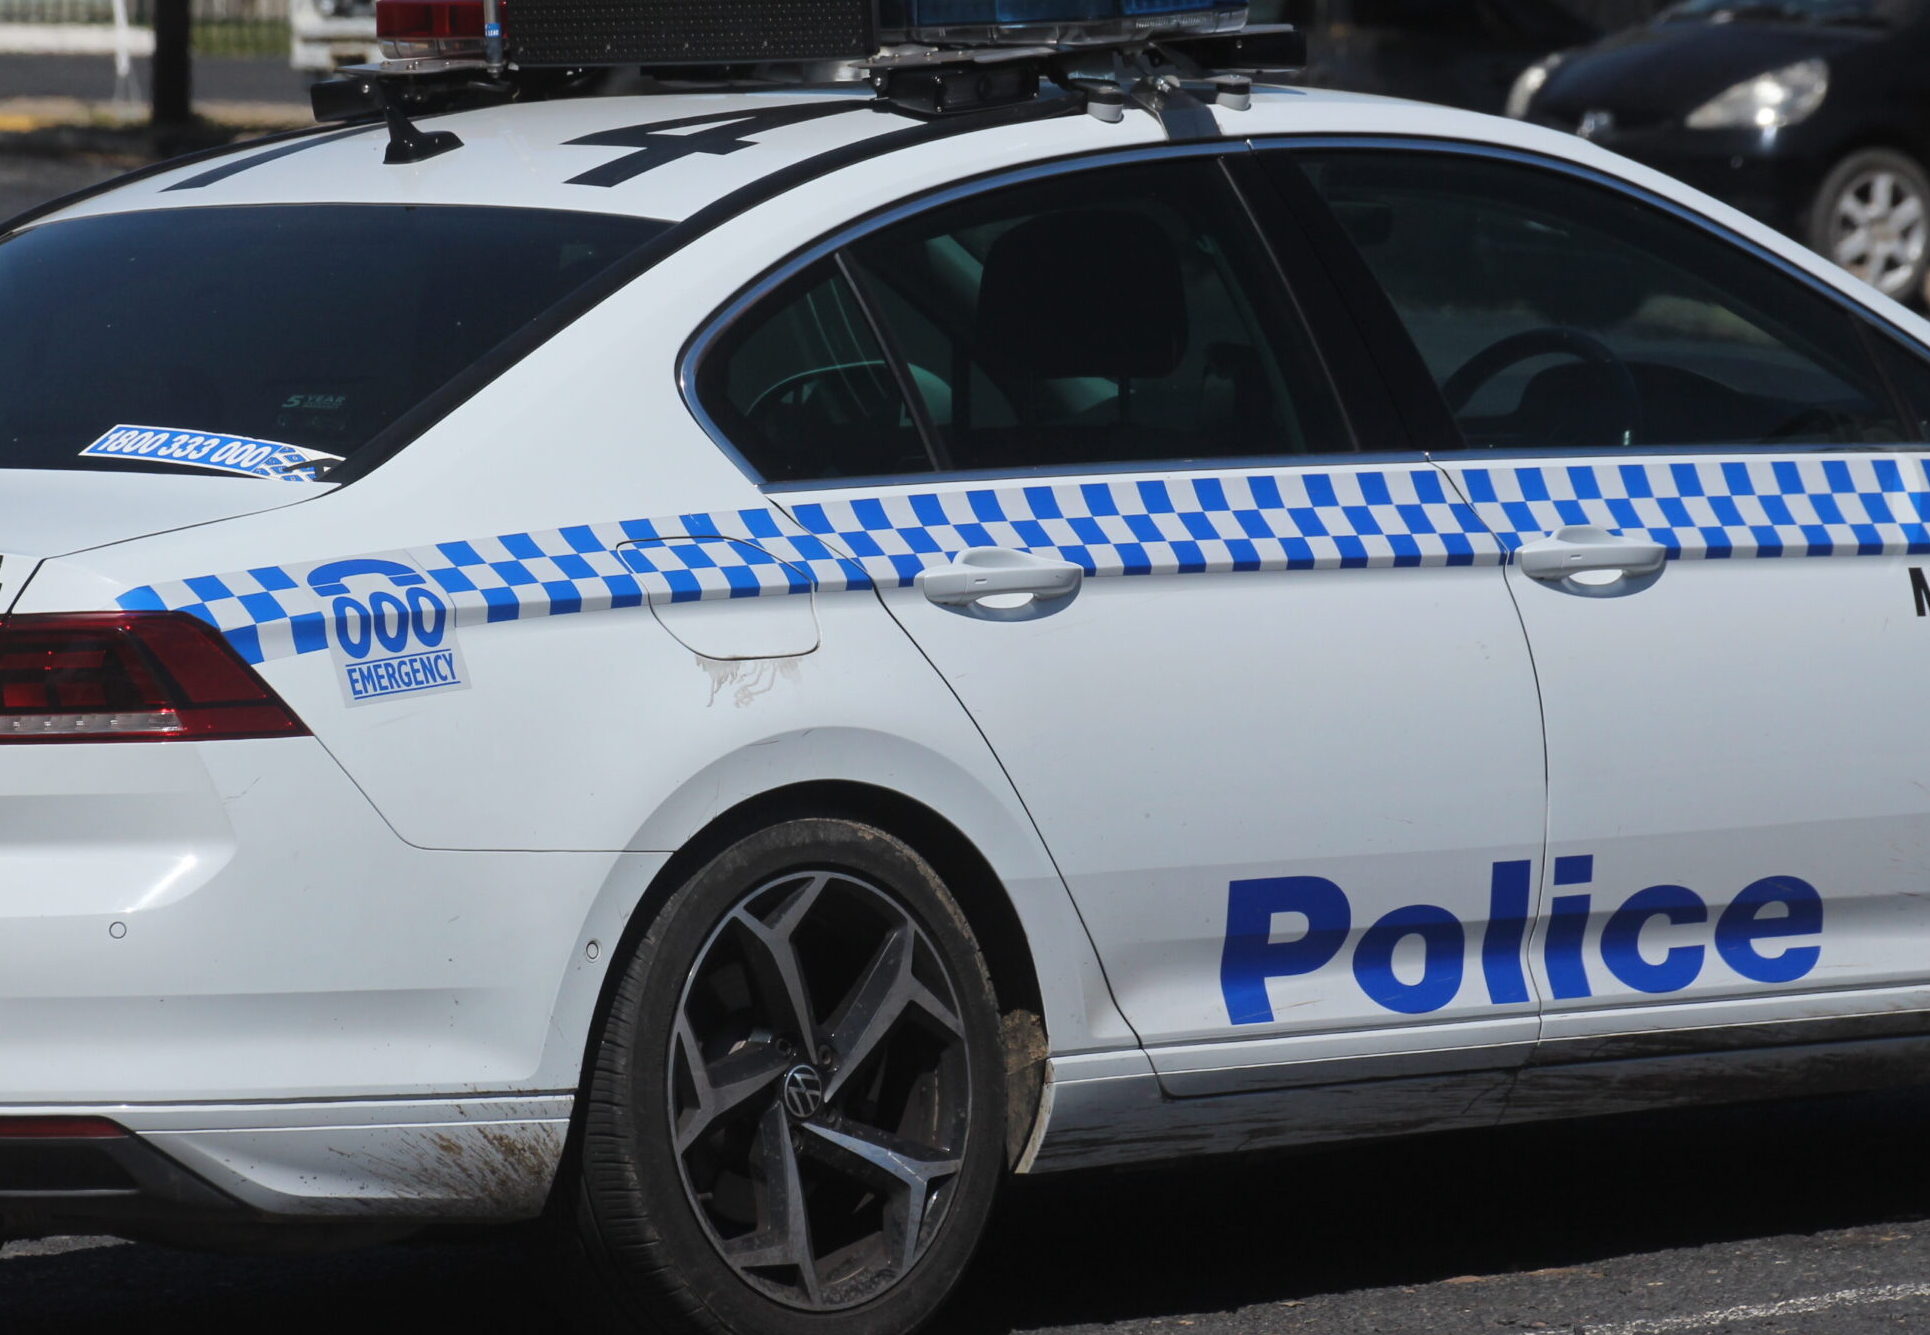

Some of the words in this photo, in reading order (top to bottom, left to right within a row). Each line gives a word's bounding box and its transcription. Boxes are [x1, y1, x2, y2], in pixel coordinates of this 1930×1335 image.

[281, 394, 304, 408] 5
[97, 428, 170, 455] 1800
[157, 434, 215, 460] 333
[209, 438, 272, 468] 000
[332, 586, 447, 659] 000
[346, 652, 457, 696] EMERGENCY
[1220, 854, 1823, 1026] Police
